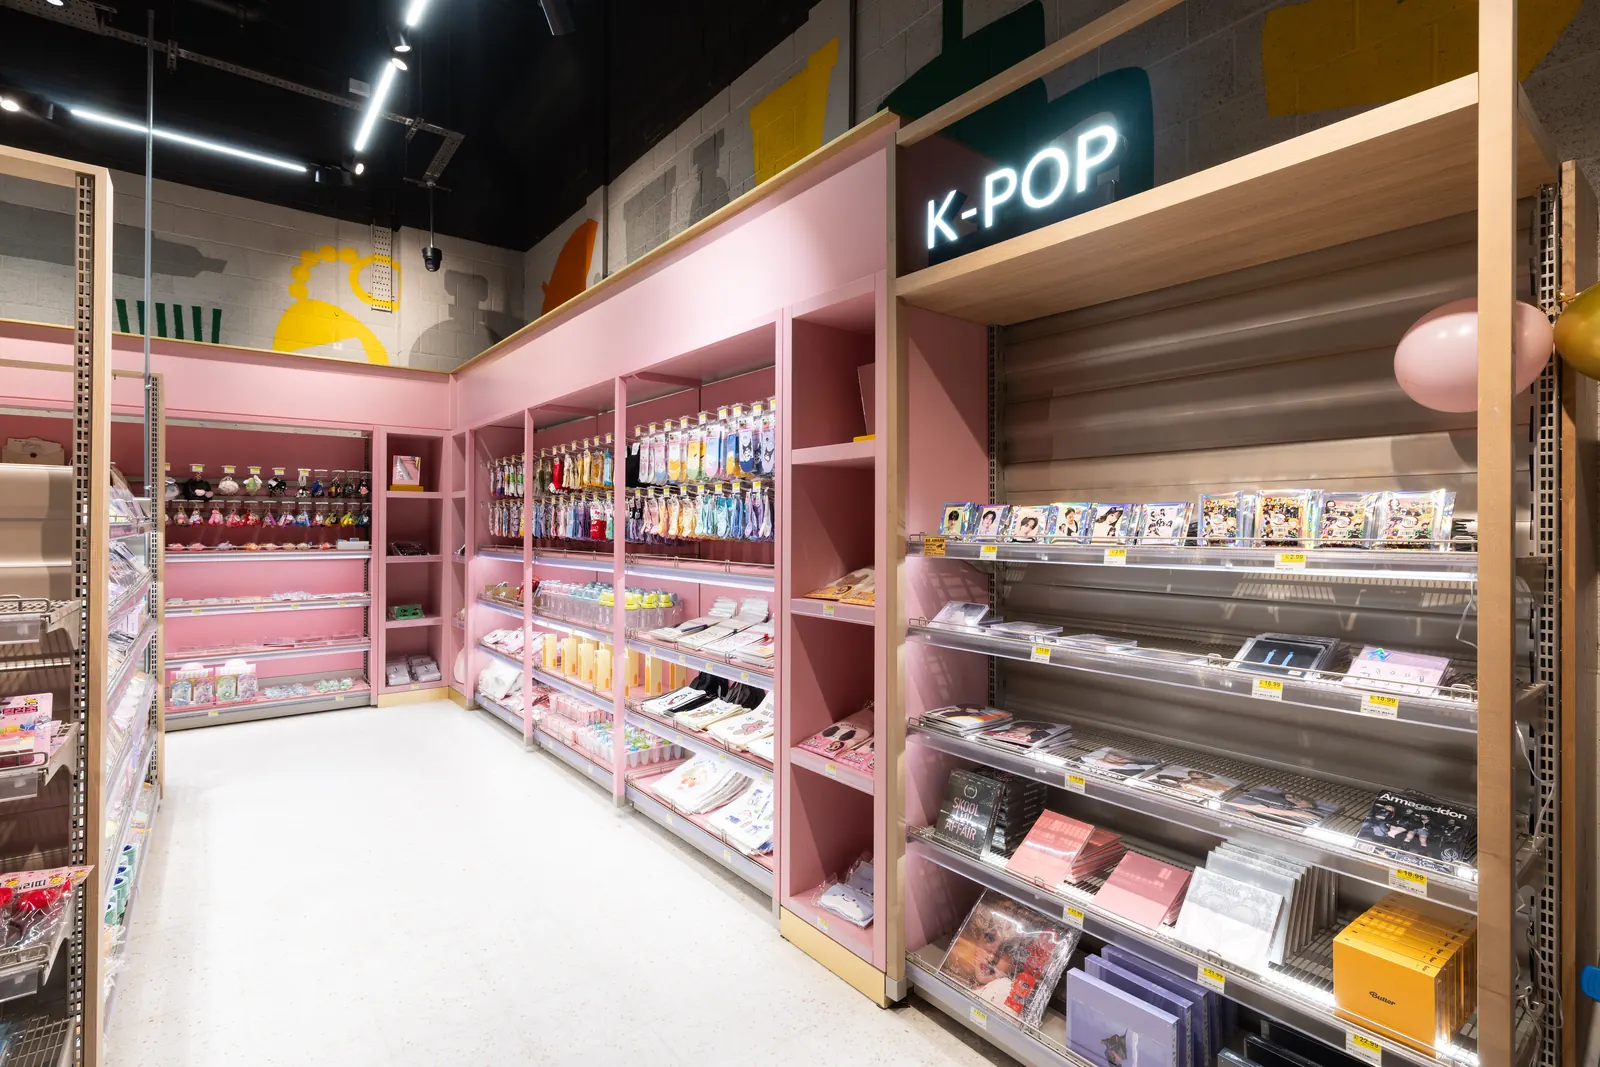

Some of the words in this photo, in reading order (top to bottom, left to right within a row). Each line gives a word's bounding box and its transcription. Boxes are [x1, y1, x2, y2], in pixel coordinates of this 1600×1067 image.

[926, 123, 1119, 250] K-POP
[952, 797, 979, 817] SKOOL
[1379, 793, 1468, 821] Armageddon
[945, 819, 977, 841] AFFAIR
[1368, 990, 1396, 1006] Butter
